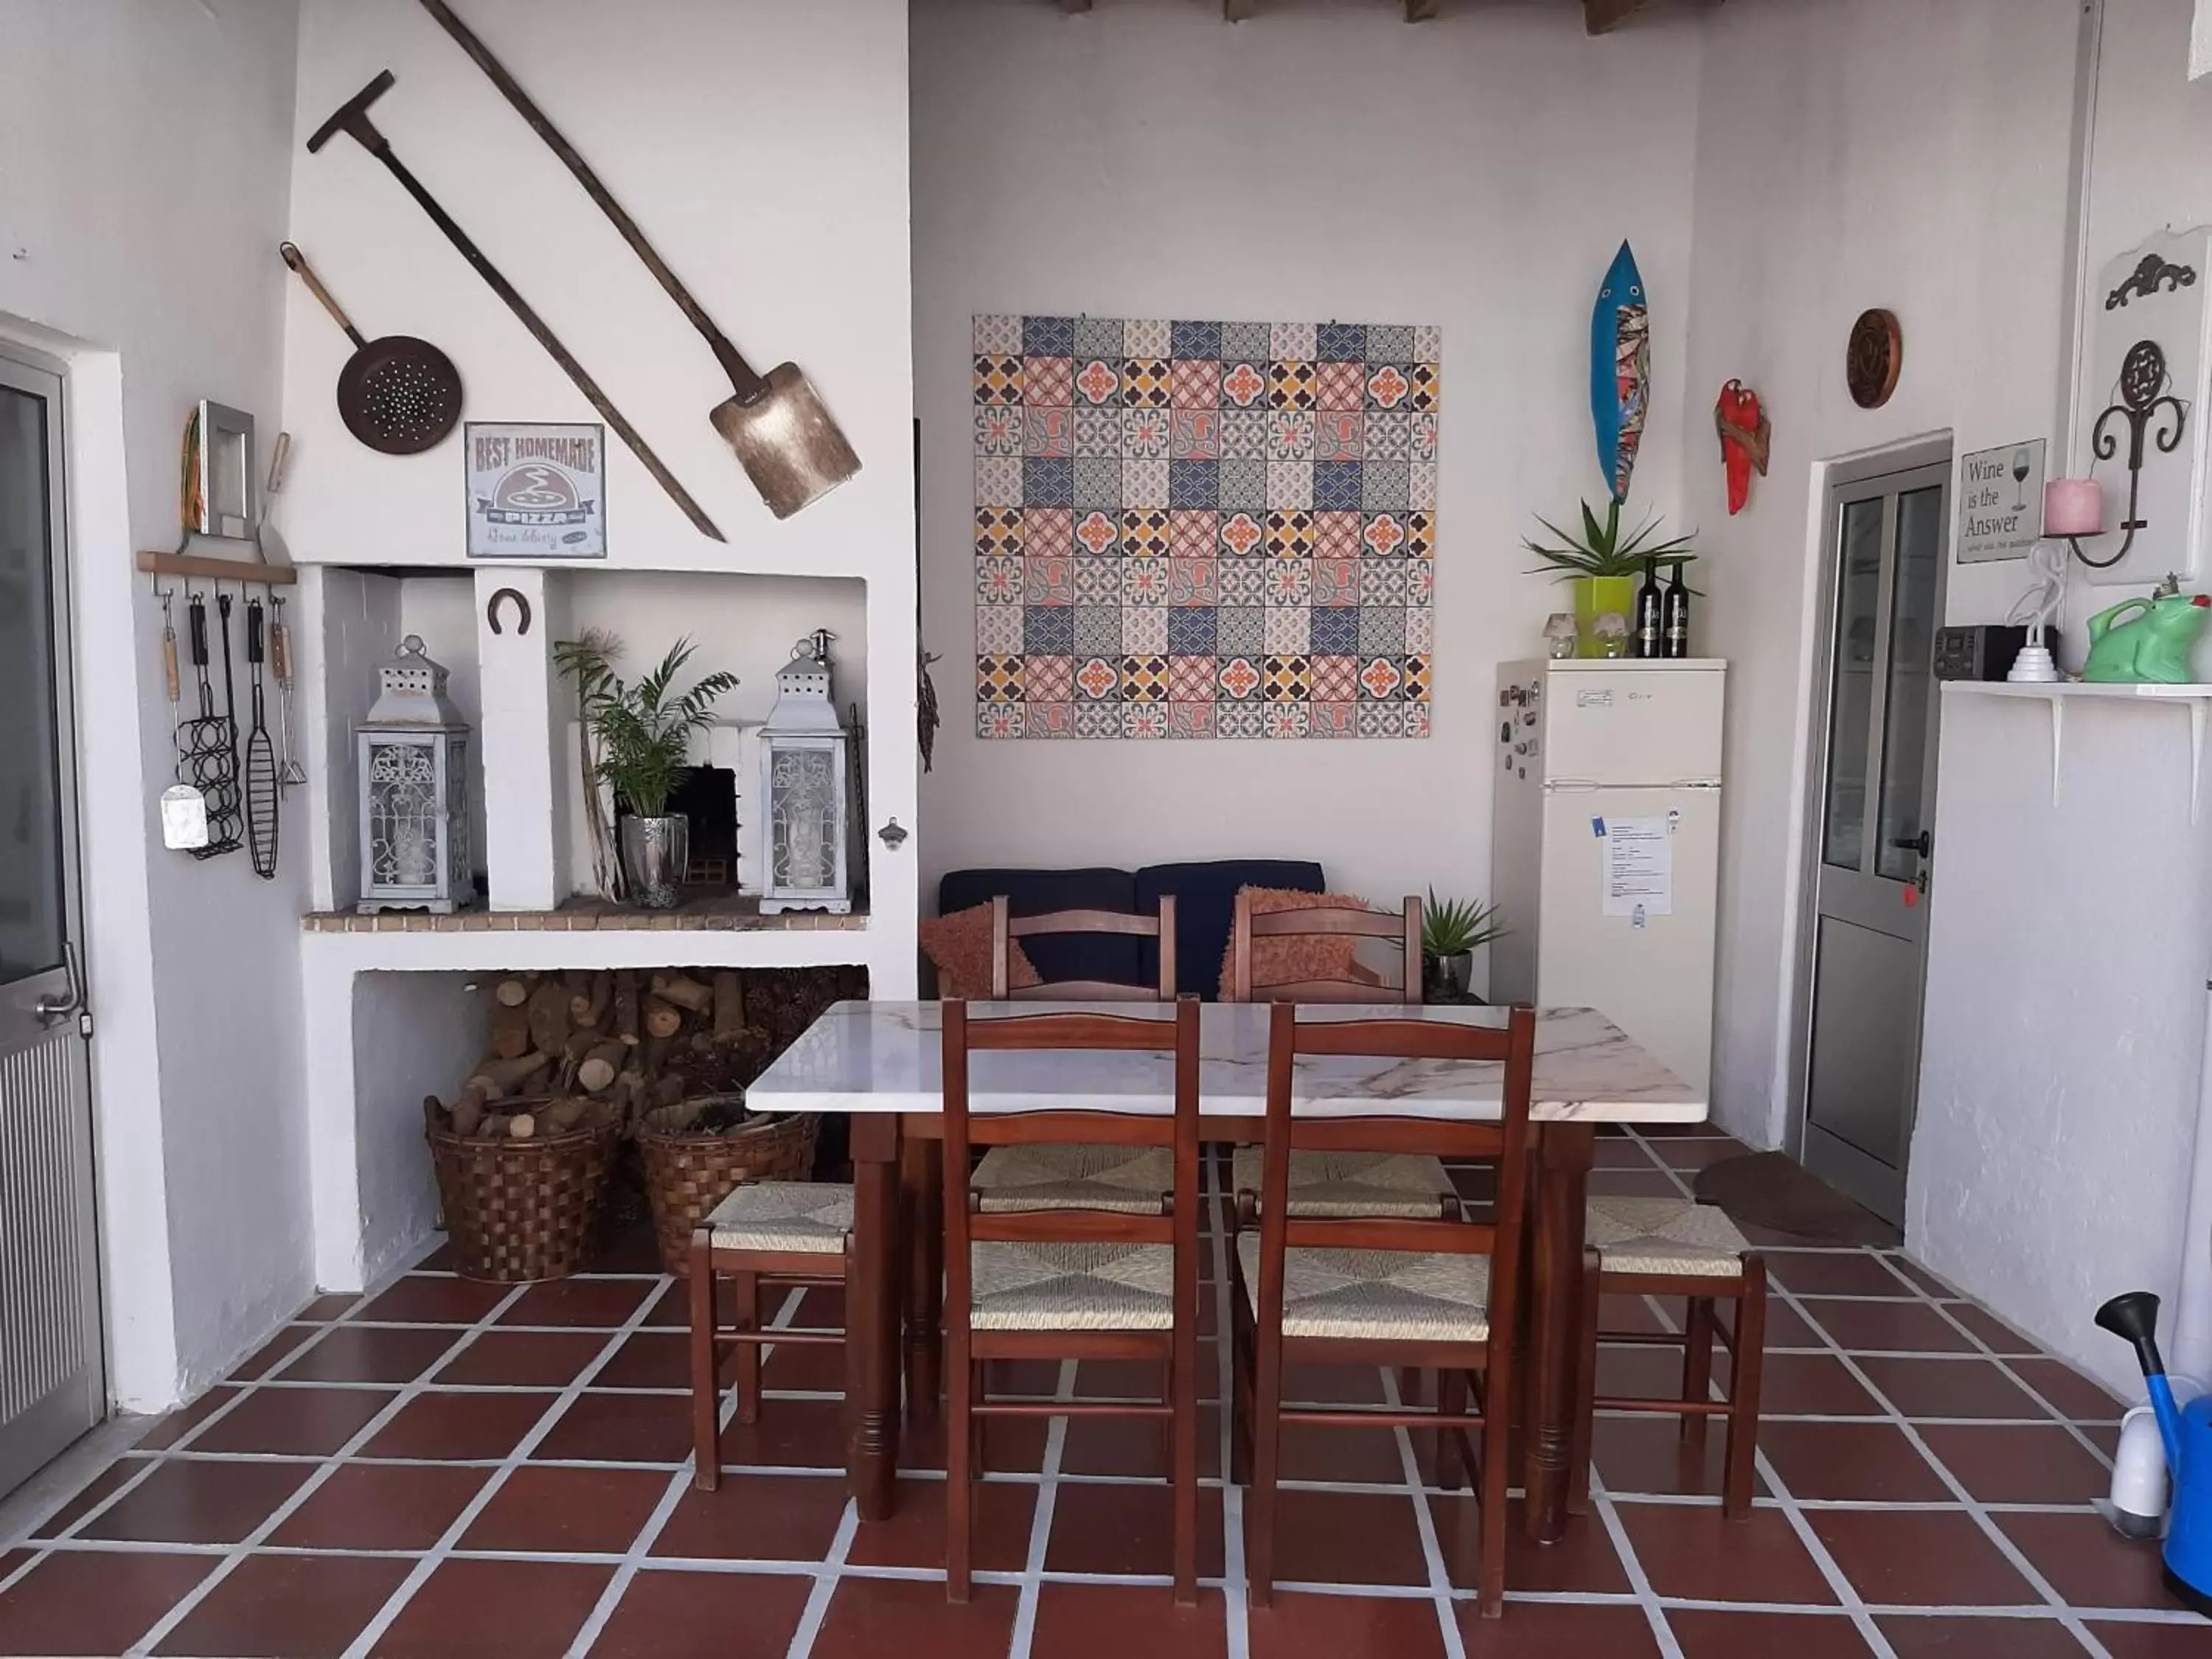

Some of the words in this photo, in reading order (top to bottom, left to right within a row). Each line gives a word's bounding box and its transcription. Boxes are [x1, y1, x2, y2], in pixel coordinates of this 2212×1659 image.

[476, 437, 511, 472] BEST
[515, 437, 595, 473] HOMEMADE
[1969, 461, 2004, 481] Wine
[1968, 490, 1977, 509] is
[1980, 487, 1999, 507] the
[505, 512, 566, 524] PIZZA
[1965, 515, 2018, 537] Answer
